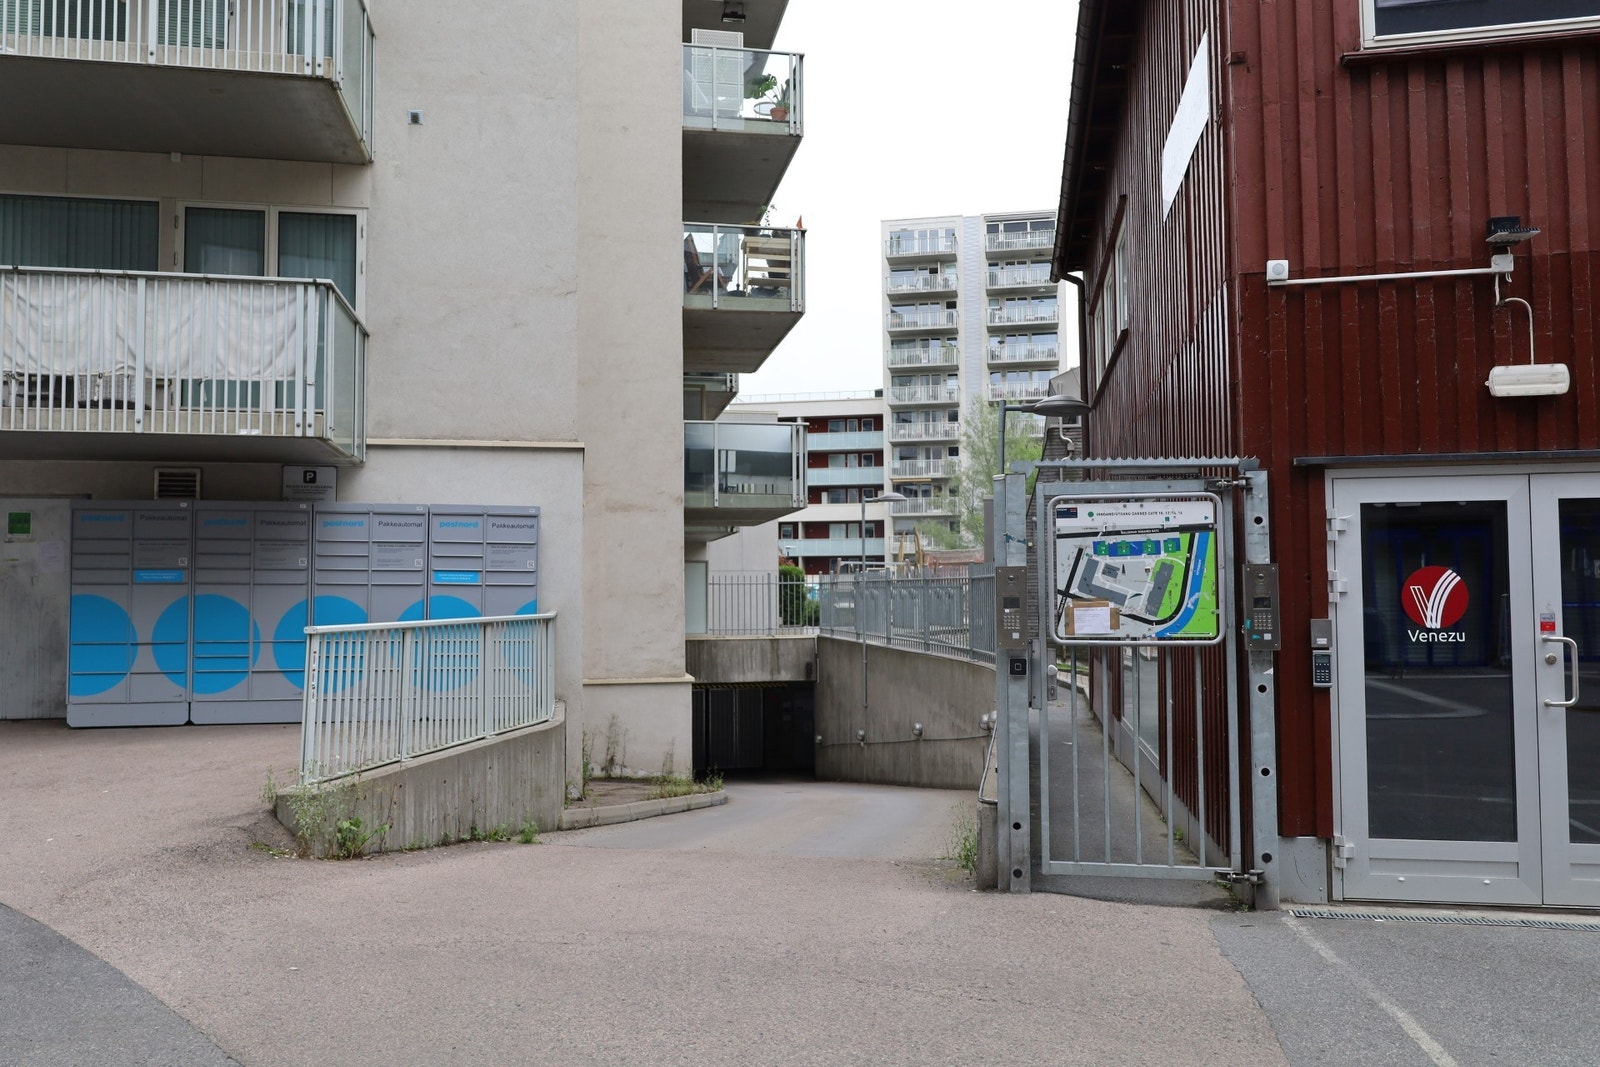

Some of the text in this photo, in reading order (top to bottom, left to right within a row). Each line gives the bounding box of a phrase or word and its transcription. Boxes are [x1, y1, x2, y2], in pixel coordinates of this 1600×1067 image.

[139, 513, 187, 521] Pakkeautomat
[260, 519, 307, 527] Pakkeautomat
[322, 520, 364, 529] postnord
[378, 520, 423, 528] Pakkeautomat
[439, 520, 479, 529] postnord
[491, 522, 535, 530] Pakkeautomat
[1407, 629, 1466, 643] Venezu
